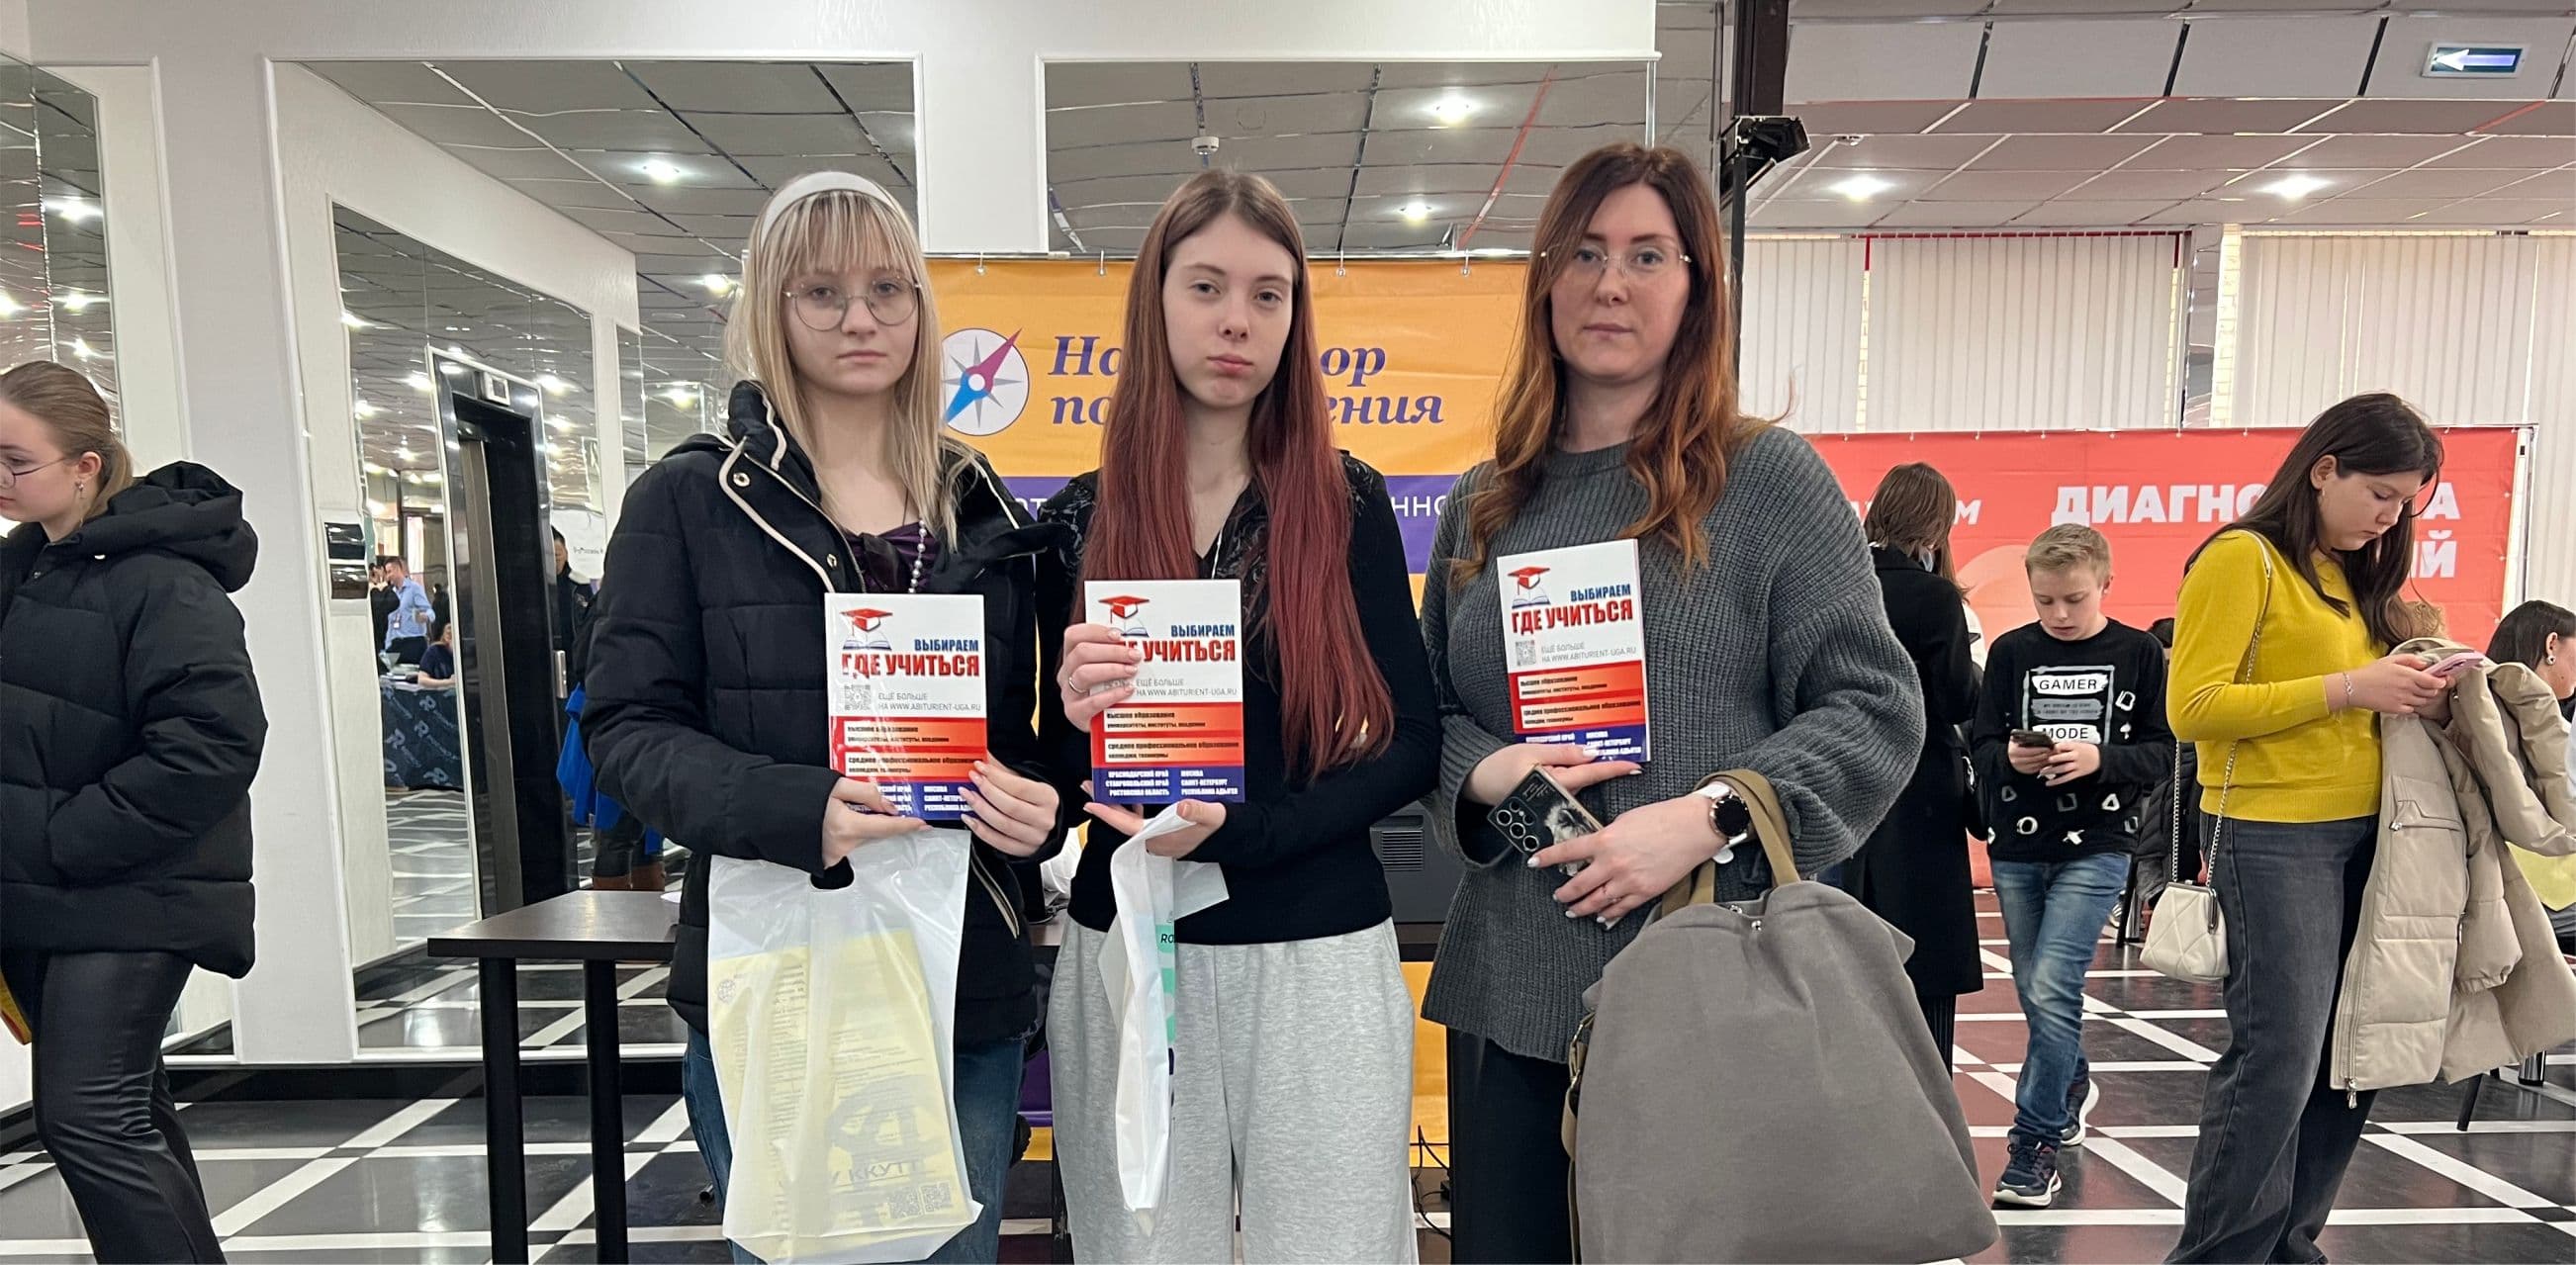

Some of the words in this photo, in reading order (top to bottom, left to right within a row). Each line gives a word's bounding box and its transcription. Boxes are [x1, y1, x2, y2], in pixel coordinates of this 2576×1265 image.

[1571, 584, 1631, 602] ВЫБИРАЕМ
[1512, 609, 1543, 635] ГДЕ
[1546, 599, 1633, 629] УЧИТЬСЯ
[1170, 625, 1236, 638] ВЫБИРАЕМ
[914, 639, 979, 652] ВЫБИРАЕМ
[1142, 639, 1236, 662] УЧИТЬСЯ
[841, 654, 881, 679] ГДЕ
[886, 654, 980, 677] УЧИТЬСЯ
[2039, 678, 2098, 690] GAMER
[2043, 727, 2089, 739] MODE
